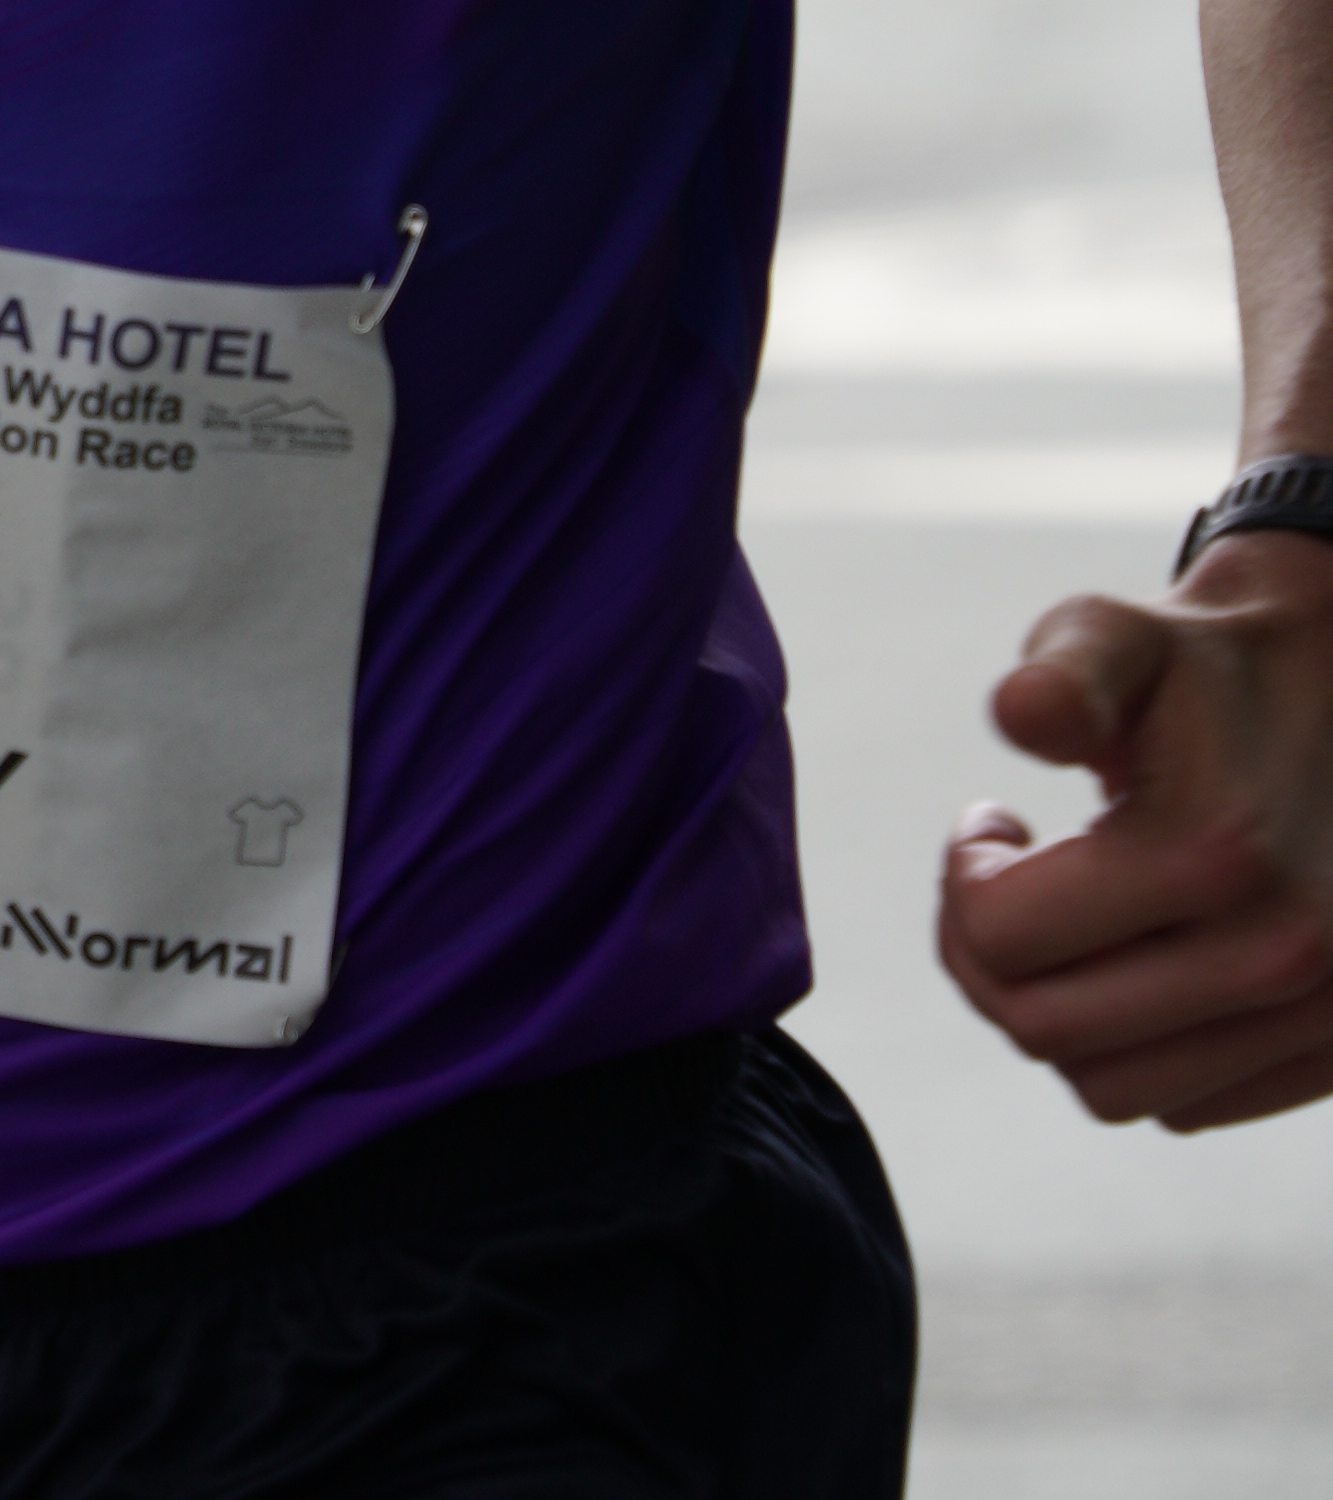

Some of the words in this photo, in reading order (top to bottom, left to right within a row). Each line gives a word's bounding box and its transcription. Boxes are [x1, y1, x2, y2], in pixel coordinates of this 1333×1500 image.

[58, 307, 291, 383] HOTEL
[4, 364, 183, 425] Wyddfa
[75, 426, 198, 473] Race
[0, 902, 294, 984] Normal
